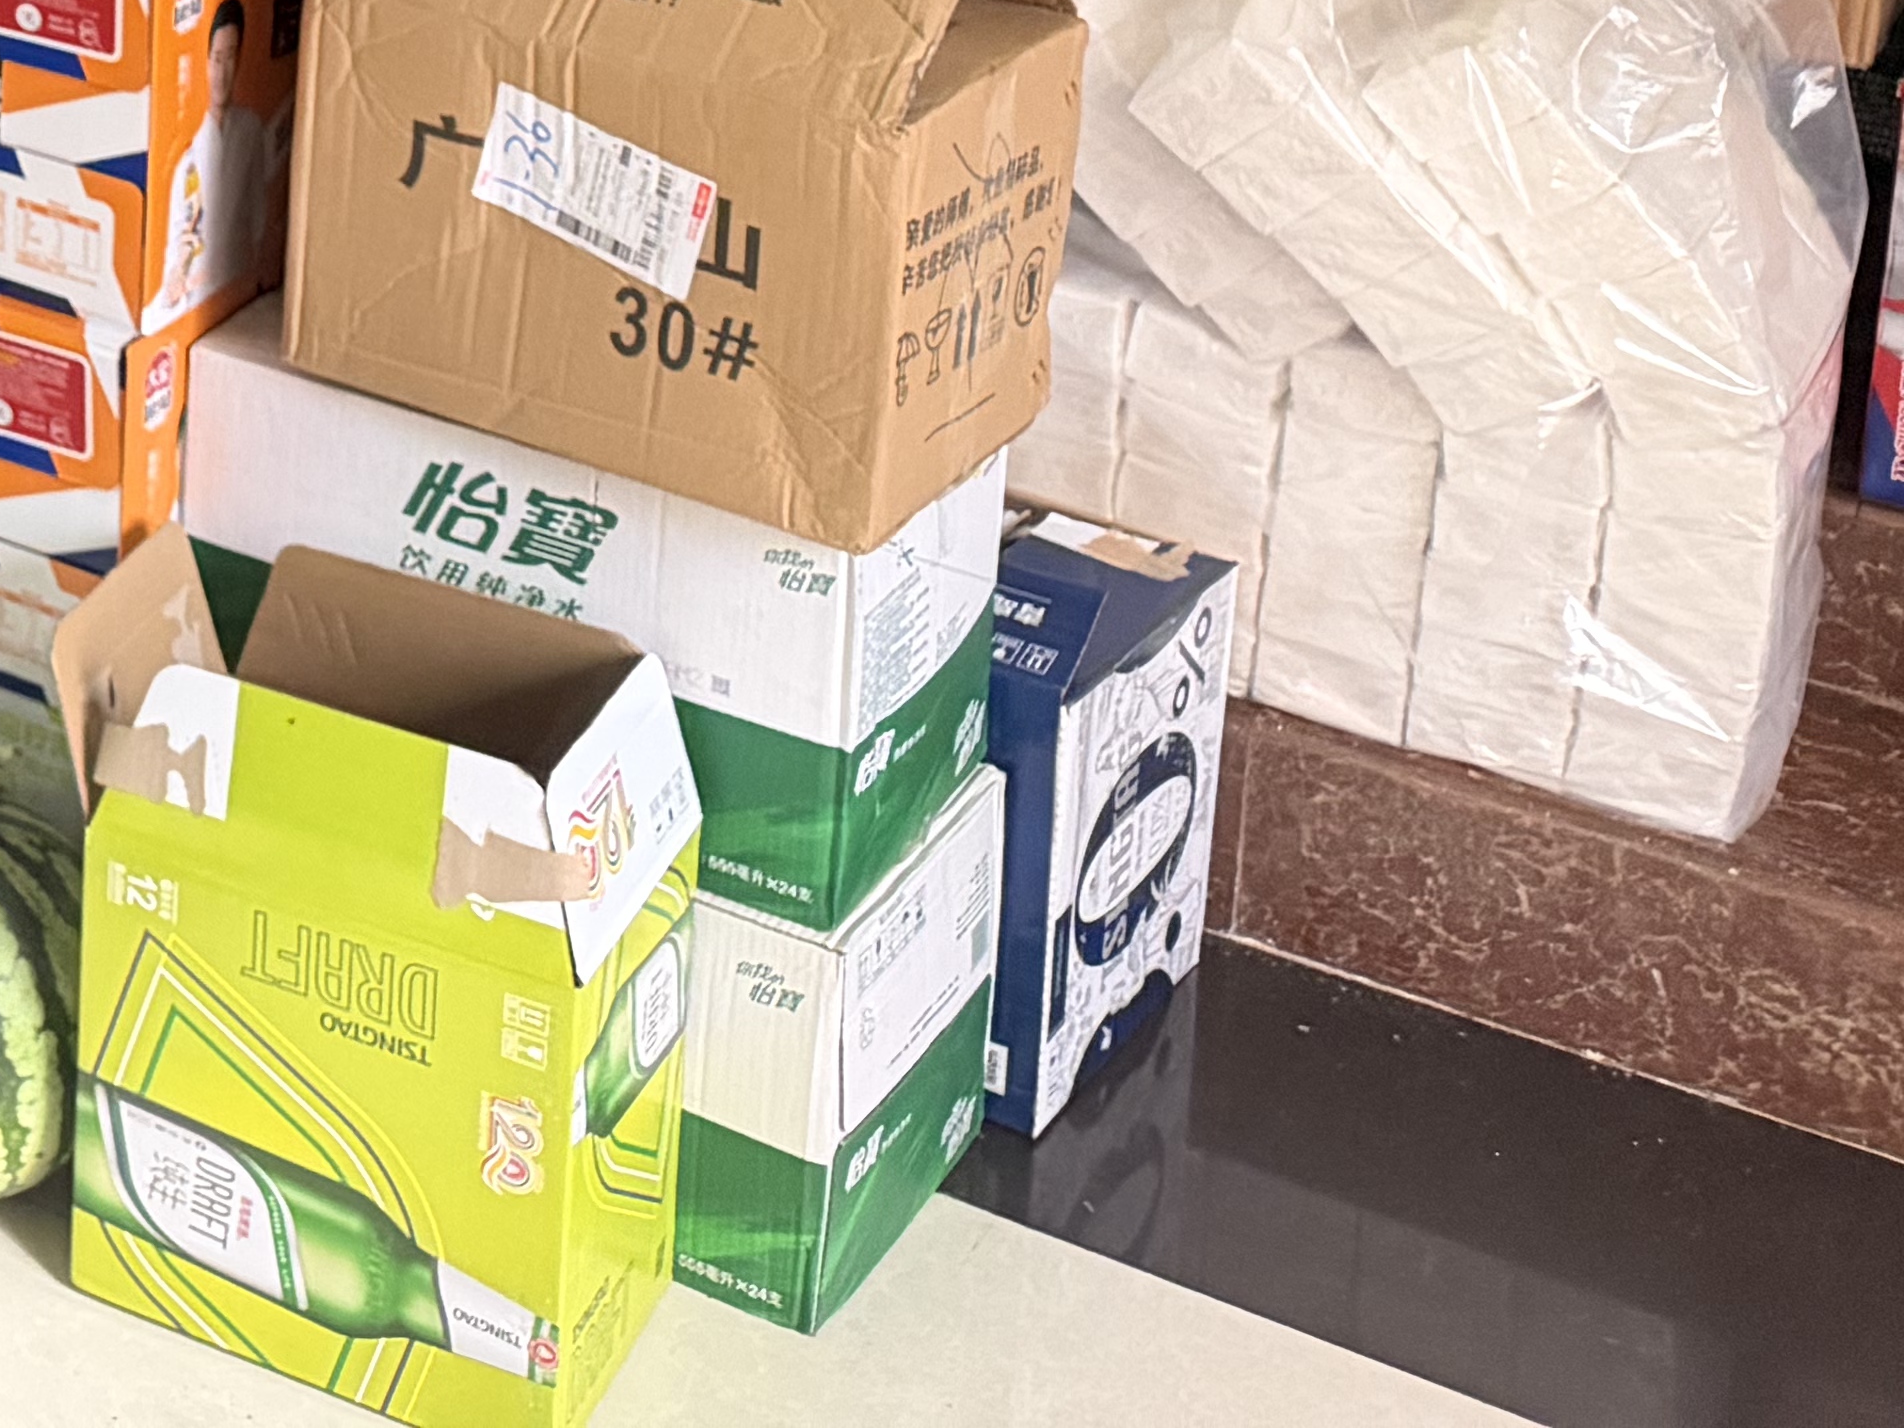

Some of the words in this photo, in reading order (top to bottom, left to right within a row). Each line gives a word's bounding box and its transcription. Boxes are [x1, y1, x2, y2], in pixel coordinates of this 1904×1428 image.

[609, 287, 758, 382] 30#
[401, 460, 619, 587] 怡寶
[398, 543, 584, 621] 饮用纯净水
[127, 874, 159, 912] 12
[242, 909, 438, 1042] DRAFT
[319, 1011, 433, 1067] TSINGTAO
[480, 1093, 545, 1196] 120
[188, 1155, 235, 1250] DRAFT
[452, 1307, 523, 1350] TSINGTAO
